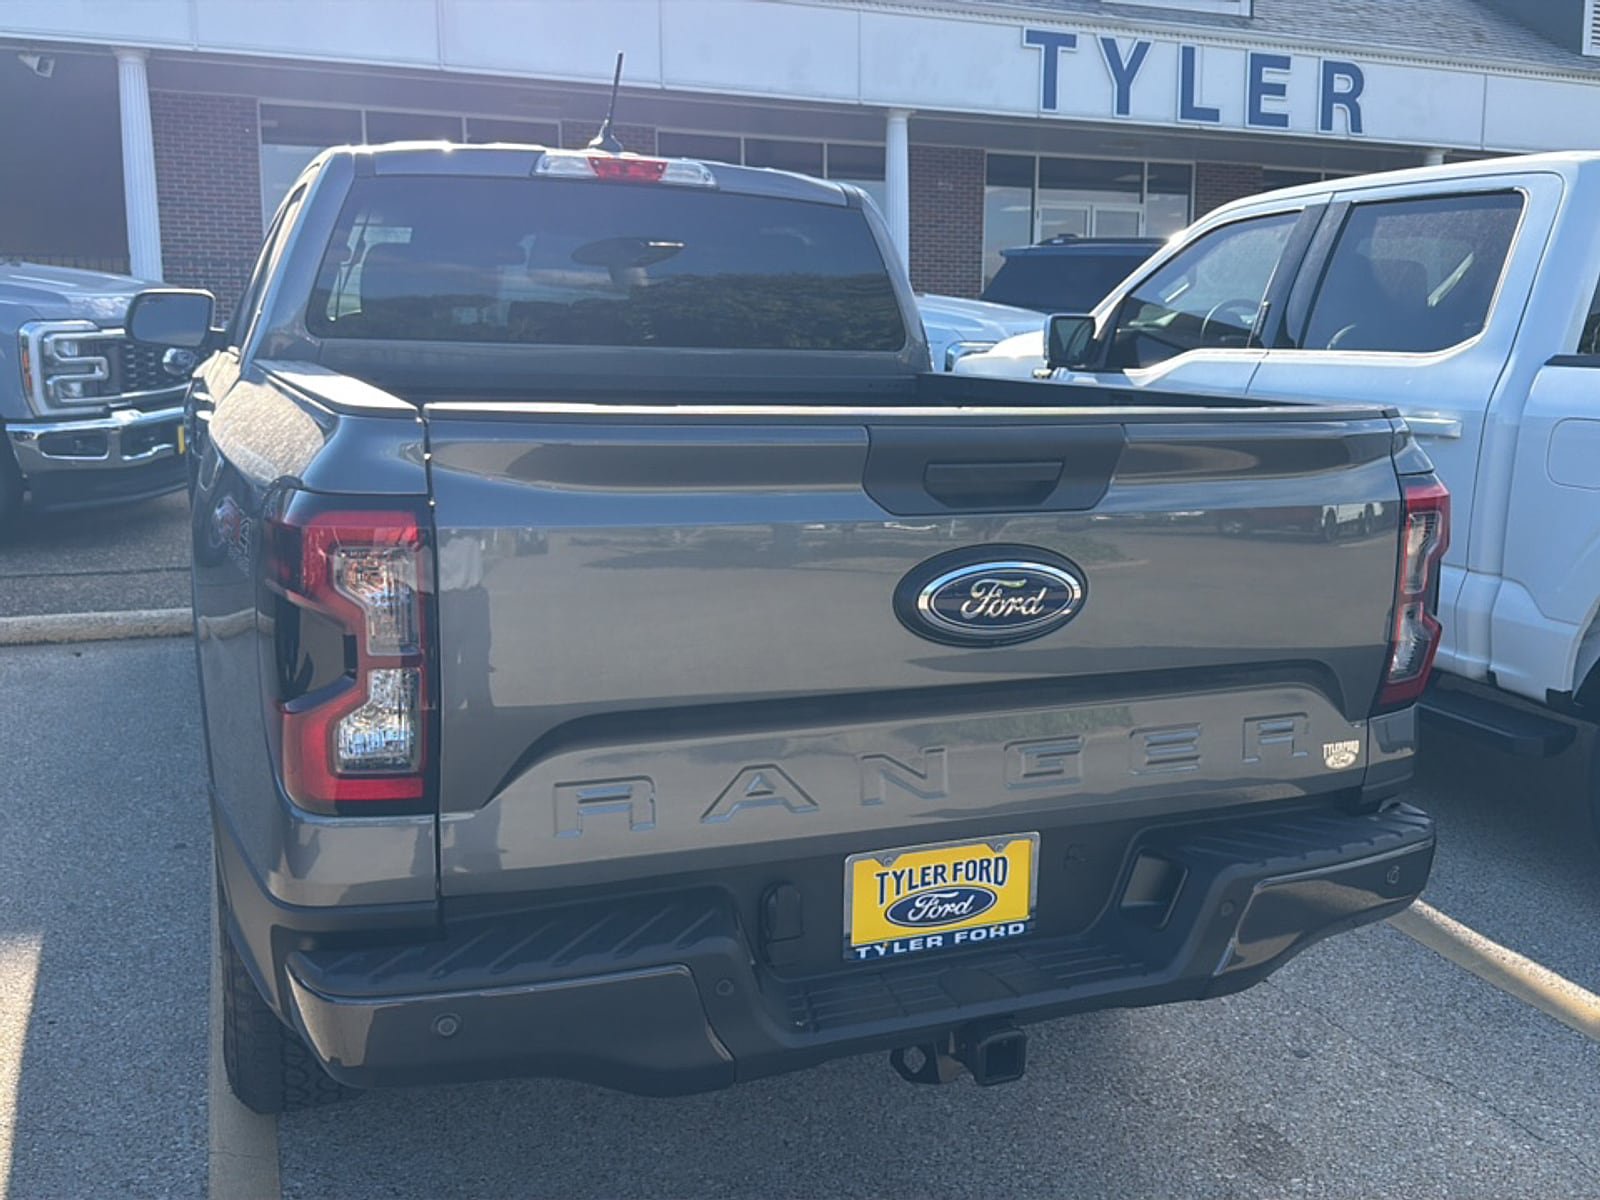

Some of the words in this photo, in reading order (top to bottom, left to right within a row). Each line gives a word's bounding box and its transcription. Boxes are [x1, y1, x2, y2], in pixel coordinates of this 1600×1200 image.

[1025, 29, 1365, 134] TYLER
[960, 578, 1047, 619] Ford
[553, 714, 1309, 837] RANGER
[876, 865, 947, 905] TYLER
[952, 856, 1008, 887] FORD
[907, 891, 975, 921] Ford
[855, 935, 943, 959] TYLER
[954, 923, 1025, 944] FORD
